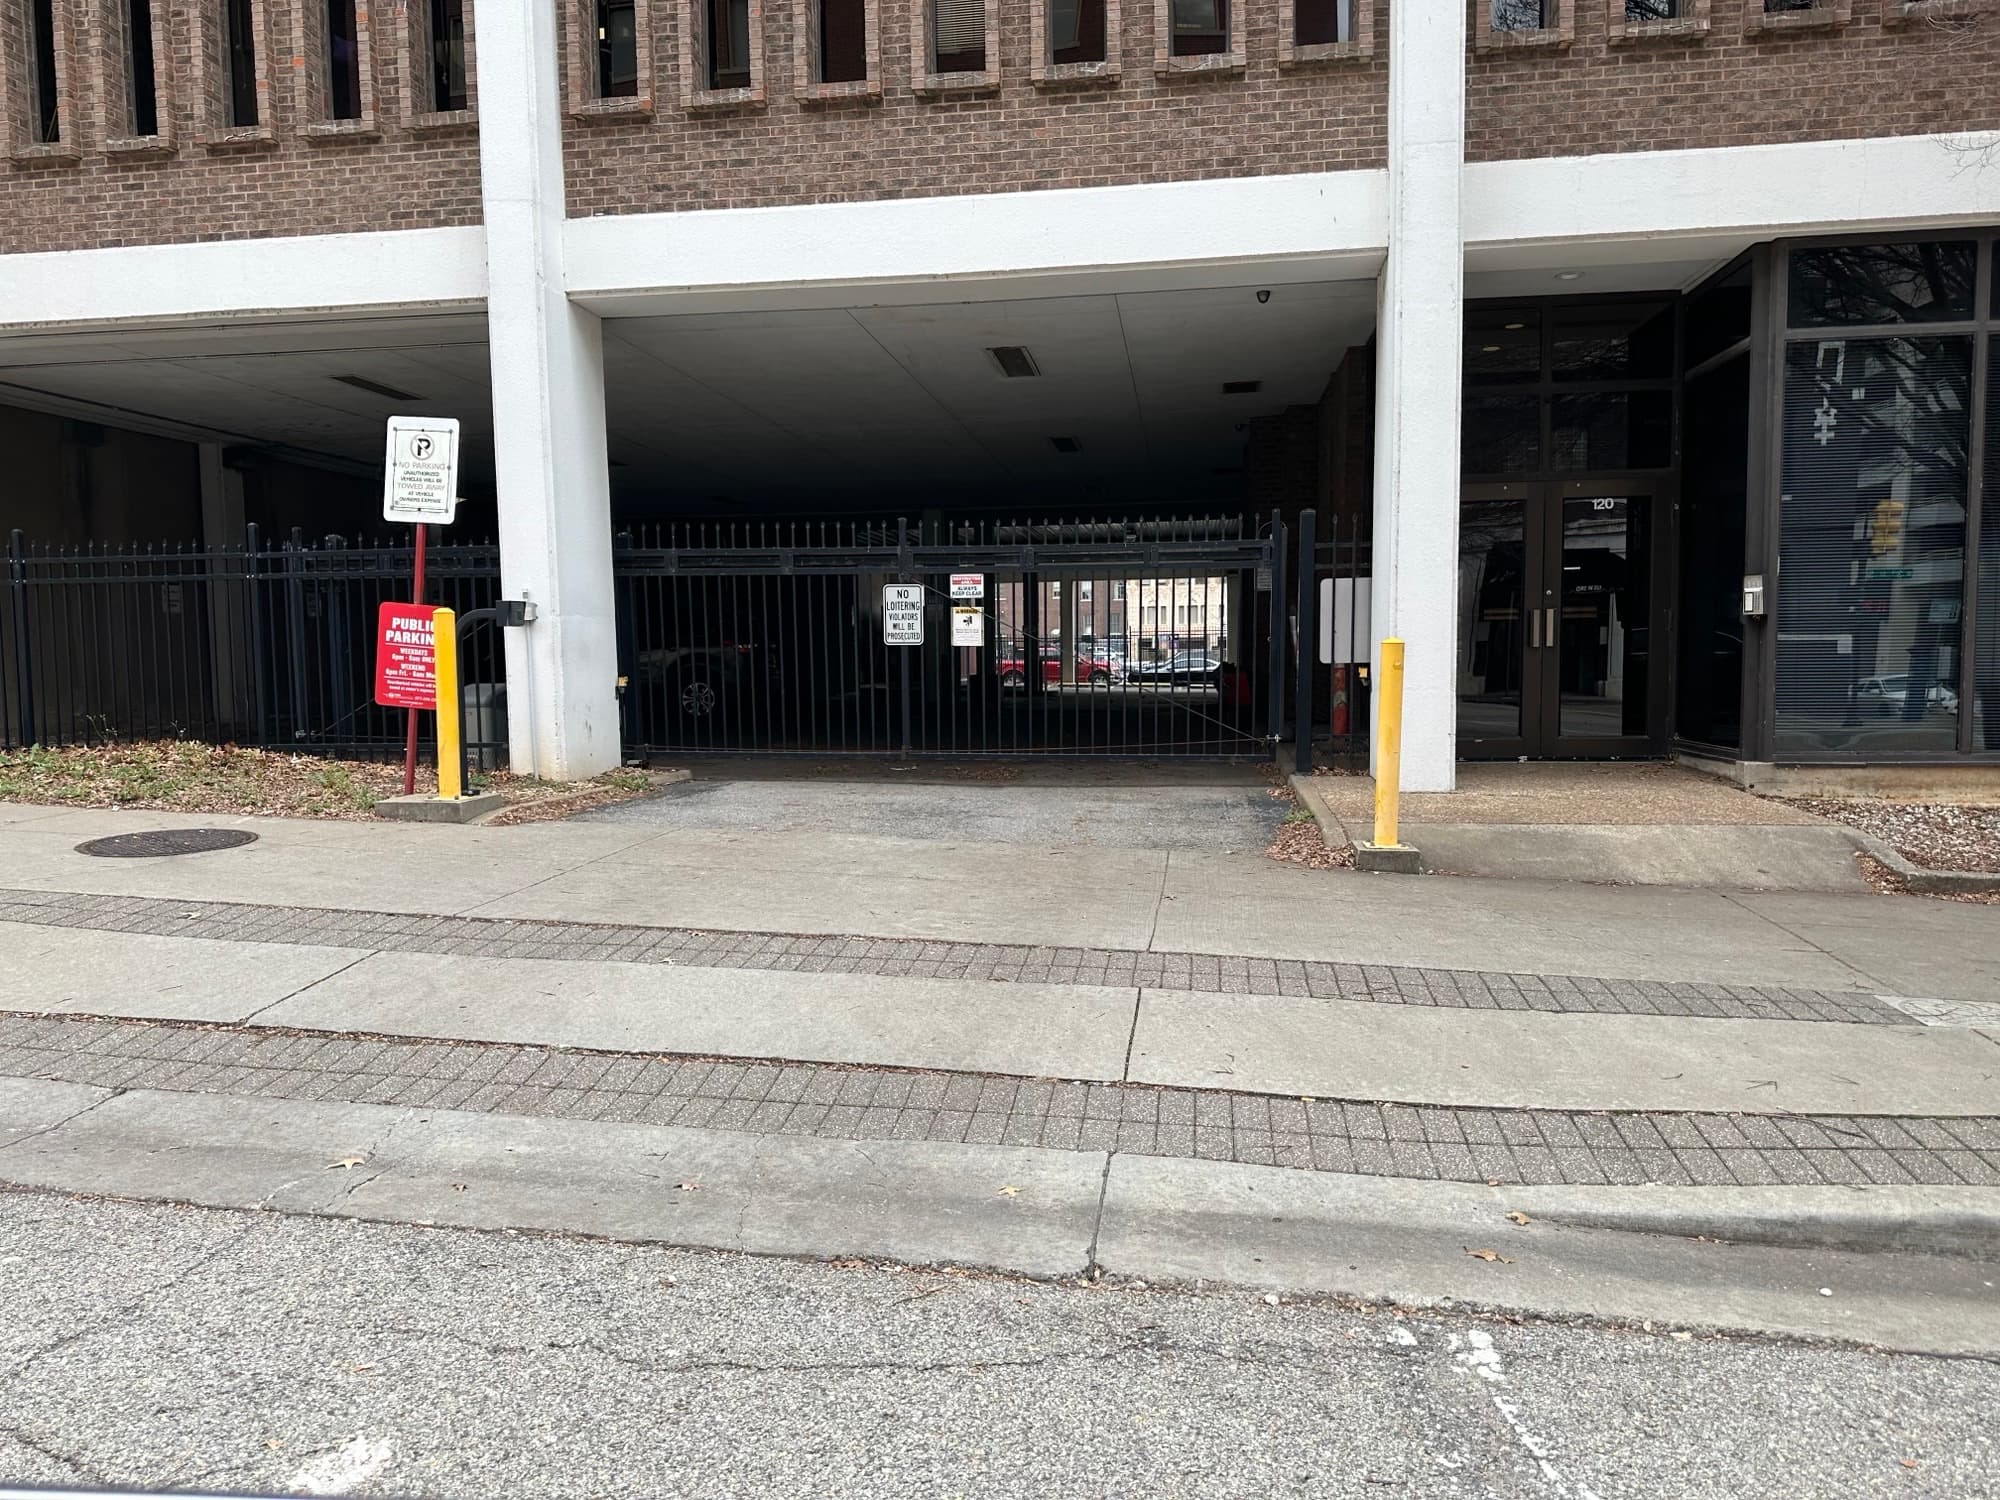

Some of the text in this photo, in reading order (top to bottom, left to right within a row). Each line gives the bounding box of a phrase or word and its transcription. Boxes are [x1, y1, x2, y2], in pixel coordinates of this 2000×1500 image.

[412, 462, 446, 470] PARKING
[1591, 498, 1614, 510] 120
[896, 589, 909, 599] NO
[886, 601, 920, 611] LOITERING
[888, 612, 918, 621] VIOLATORS
[892, 622, 914, 630] WILL BE
[385, 630, 435, 645] PARKIN
[887, 632, 920, 641] PROSECUTED
[400, 648, 428, 656] WEEKDAYS
[400, 664, 426, 672] WEEKEND
